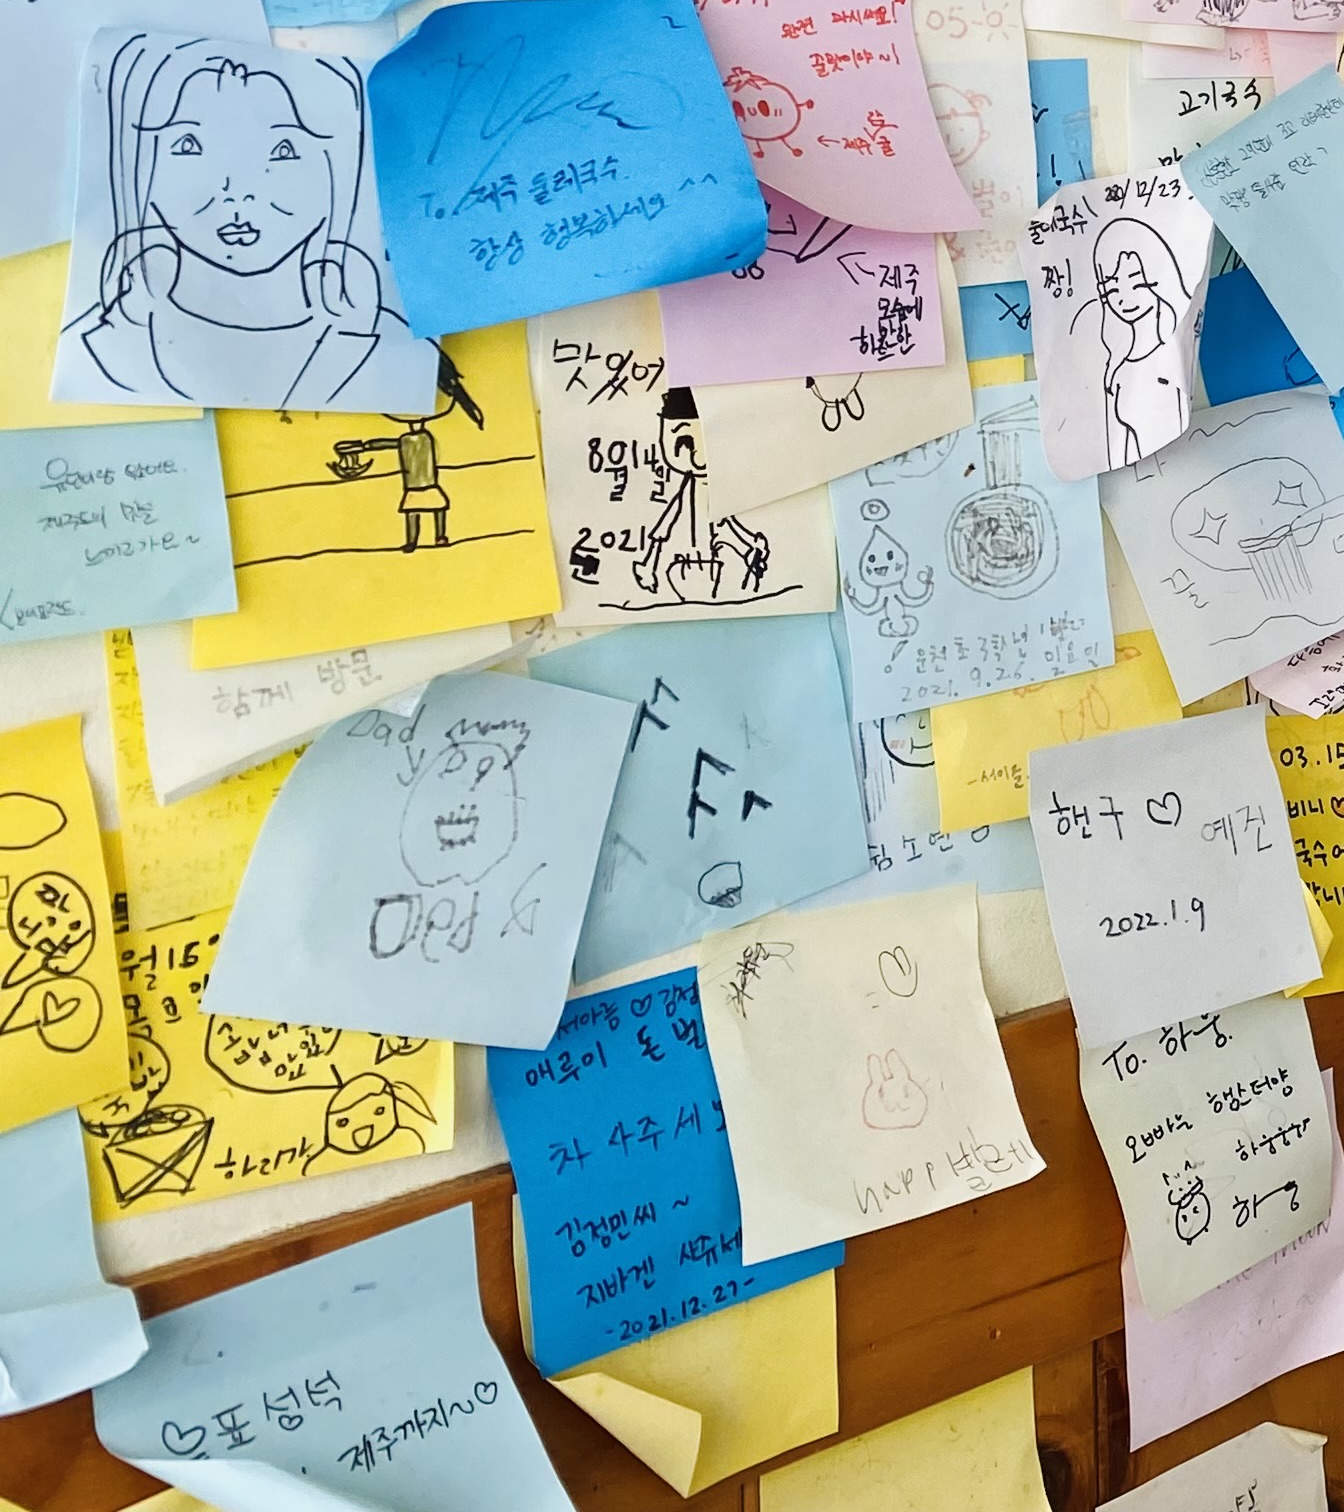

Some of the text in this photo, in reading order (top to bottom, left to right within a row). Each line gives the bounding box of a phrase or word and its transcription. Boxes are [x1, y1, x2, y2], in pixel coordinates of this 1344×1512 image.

[1179, 78, 1262, 116] 고기국수
[470, 230, 524, 271] 항상
[1041, 259, 1074, 298] 짱!
